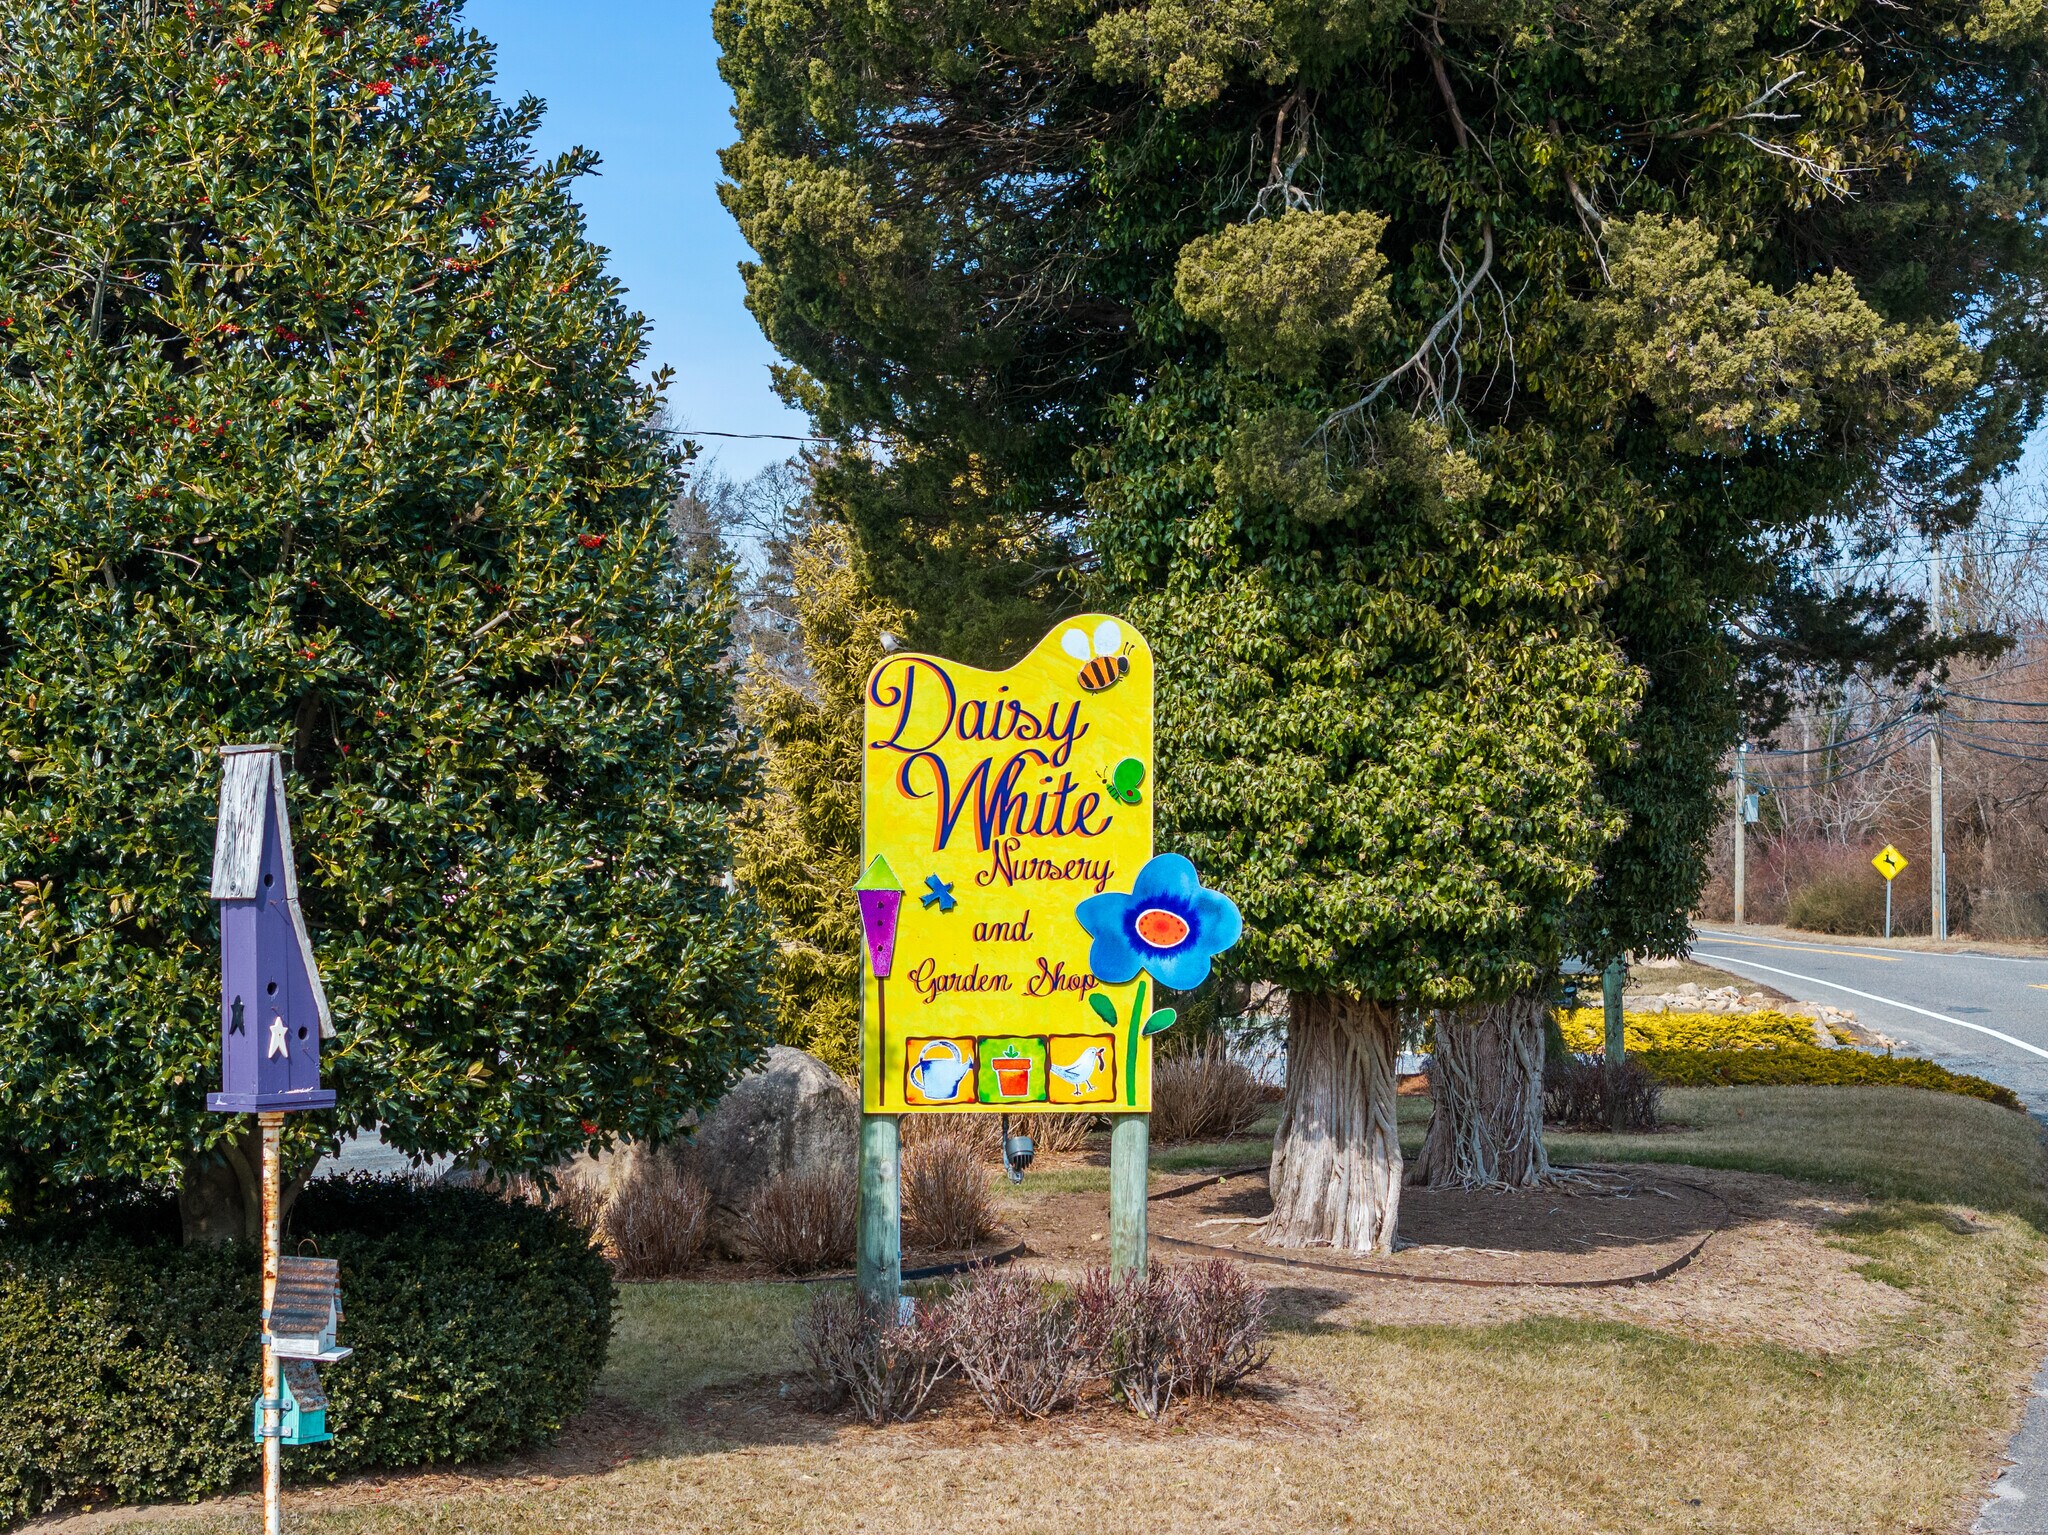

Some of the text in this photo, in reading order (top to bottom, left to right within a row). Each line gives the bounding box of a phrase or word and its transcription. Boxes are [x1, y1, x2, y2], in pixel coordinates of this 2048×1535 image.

[868, 657, 1090, 768] Daisy
[896, 749, 1113, 853] White
[975, 837, 1115, 894] Nursery
[972, 909, 1033, 942] and
[907, 957, 1100, 1004] Garden Shop
